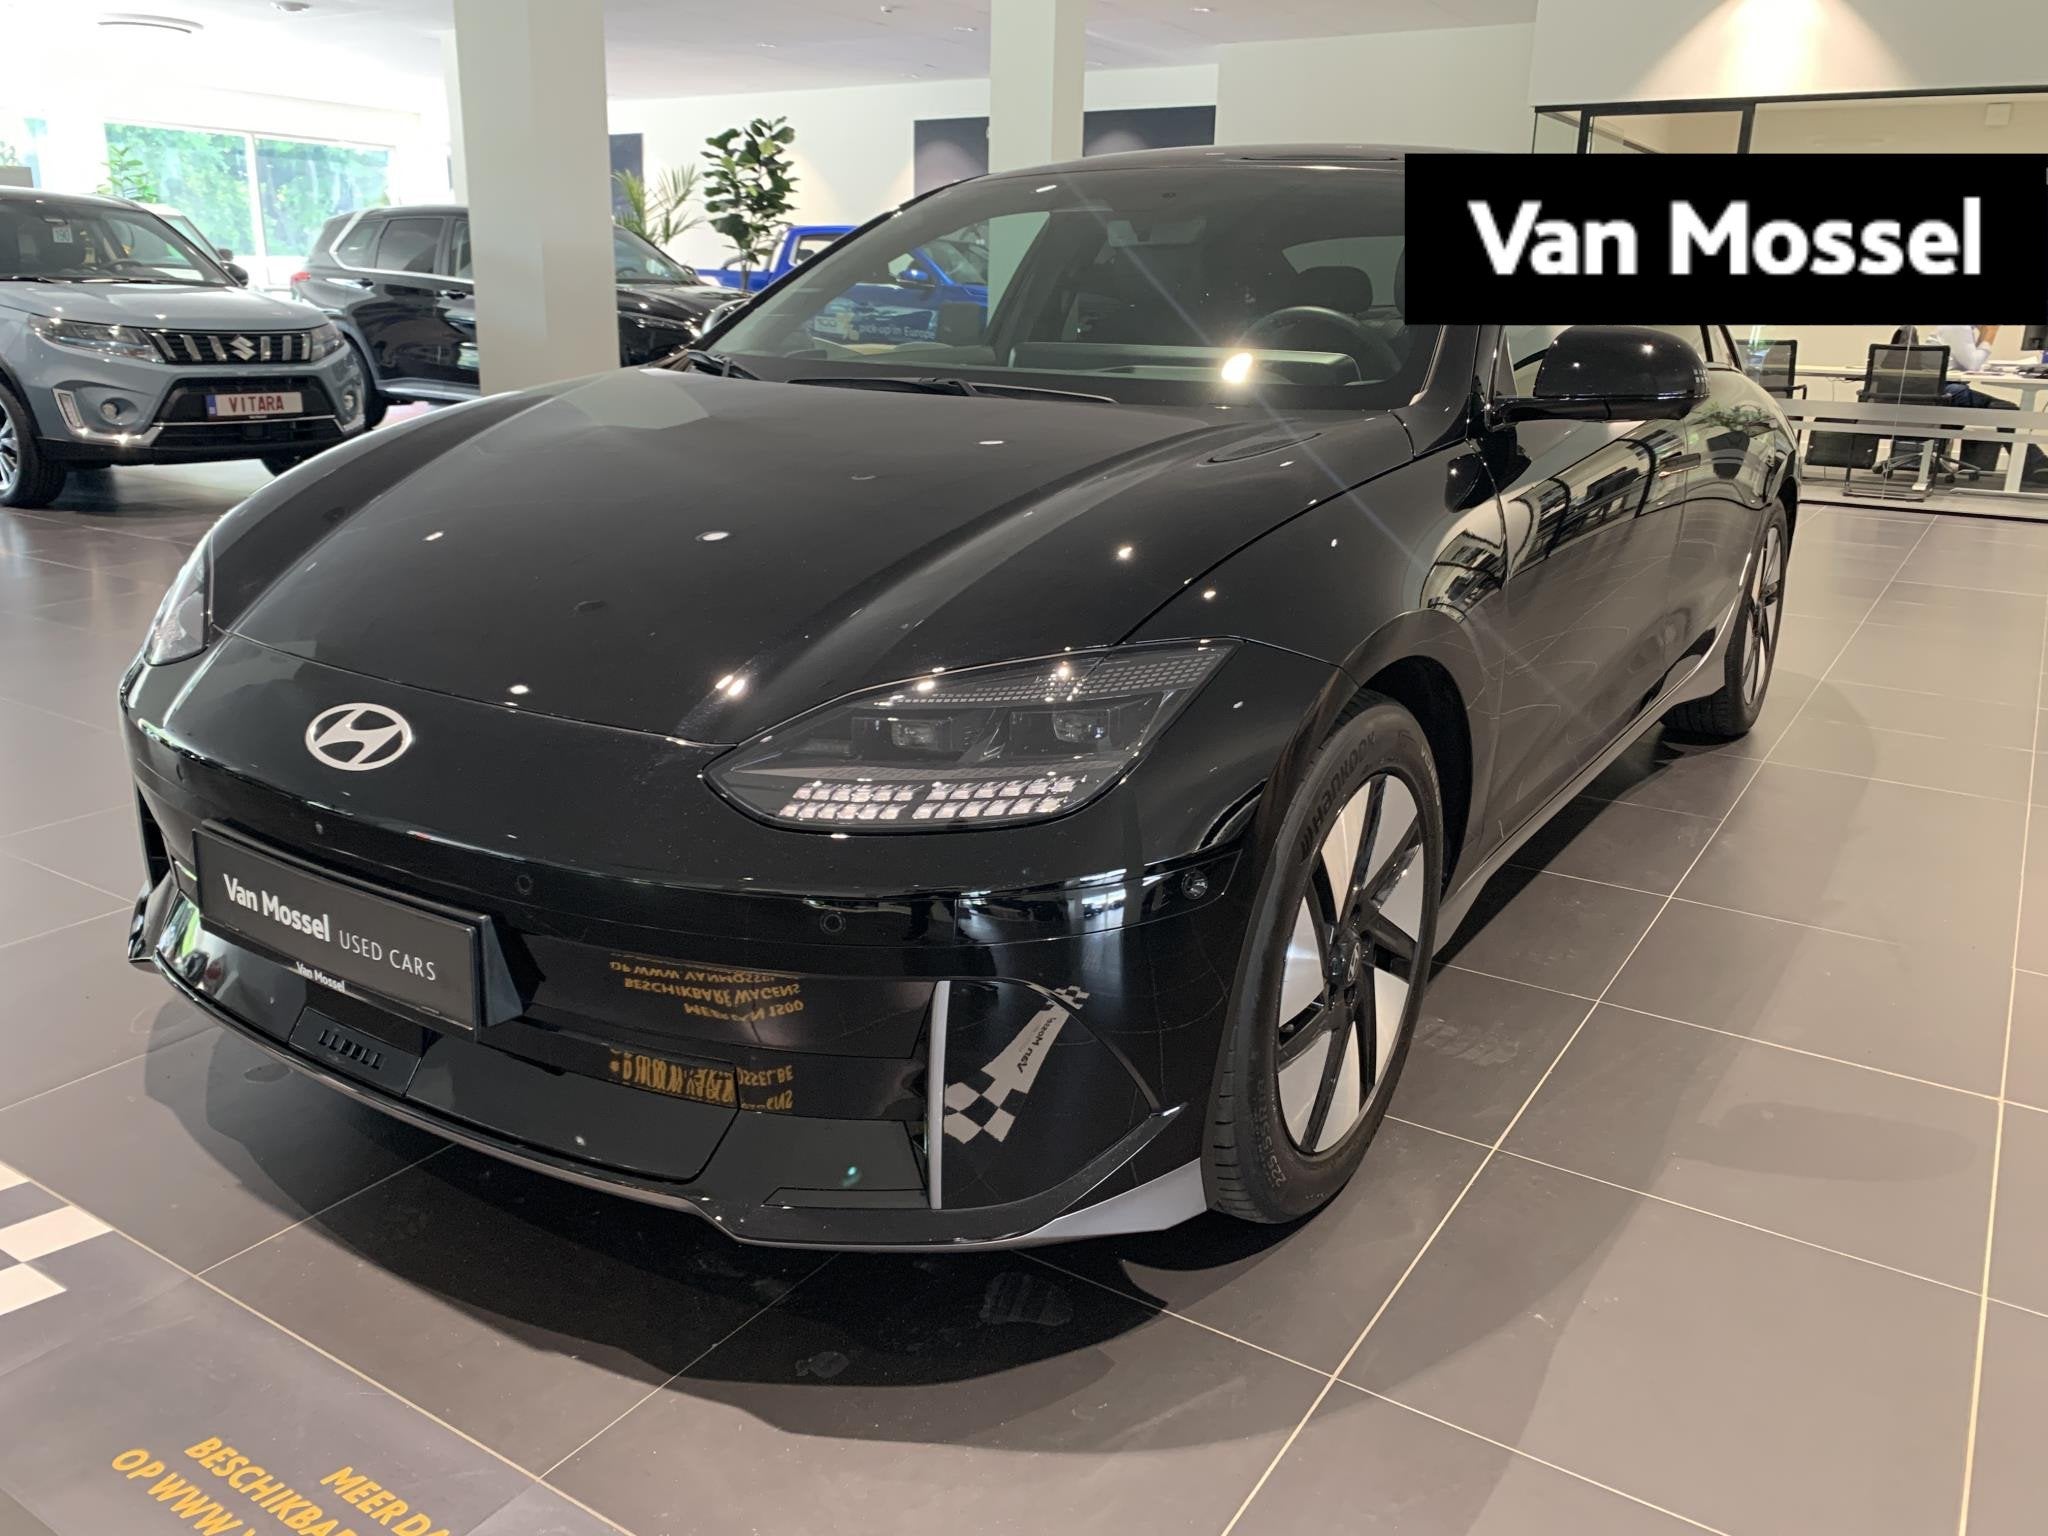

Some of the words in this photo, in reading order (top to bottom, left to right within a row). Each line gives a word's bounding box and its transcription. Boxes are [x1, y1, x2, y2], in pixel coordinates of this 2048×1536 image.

[903, 326, 936, 339] Europe
[228, 395, 285, 413] VITARA
[223, 872, 258, 912] Van
[261, 889, 331, 942] Mossel
[339, 929, 382, 960] USED
[389, 949, 436, 980] CARS
[296, 961, 313, 979] Van
[313, 969, 346, 993] Mossel
[111, 1448, 166, 1481] OP
[183, 1435, 358, 1536] BESCHIKBA
[319, 1465, 409, 1526] MEER
